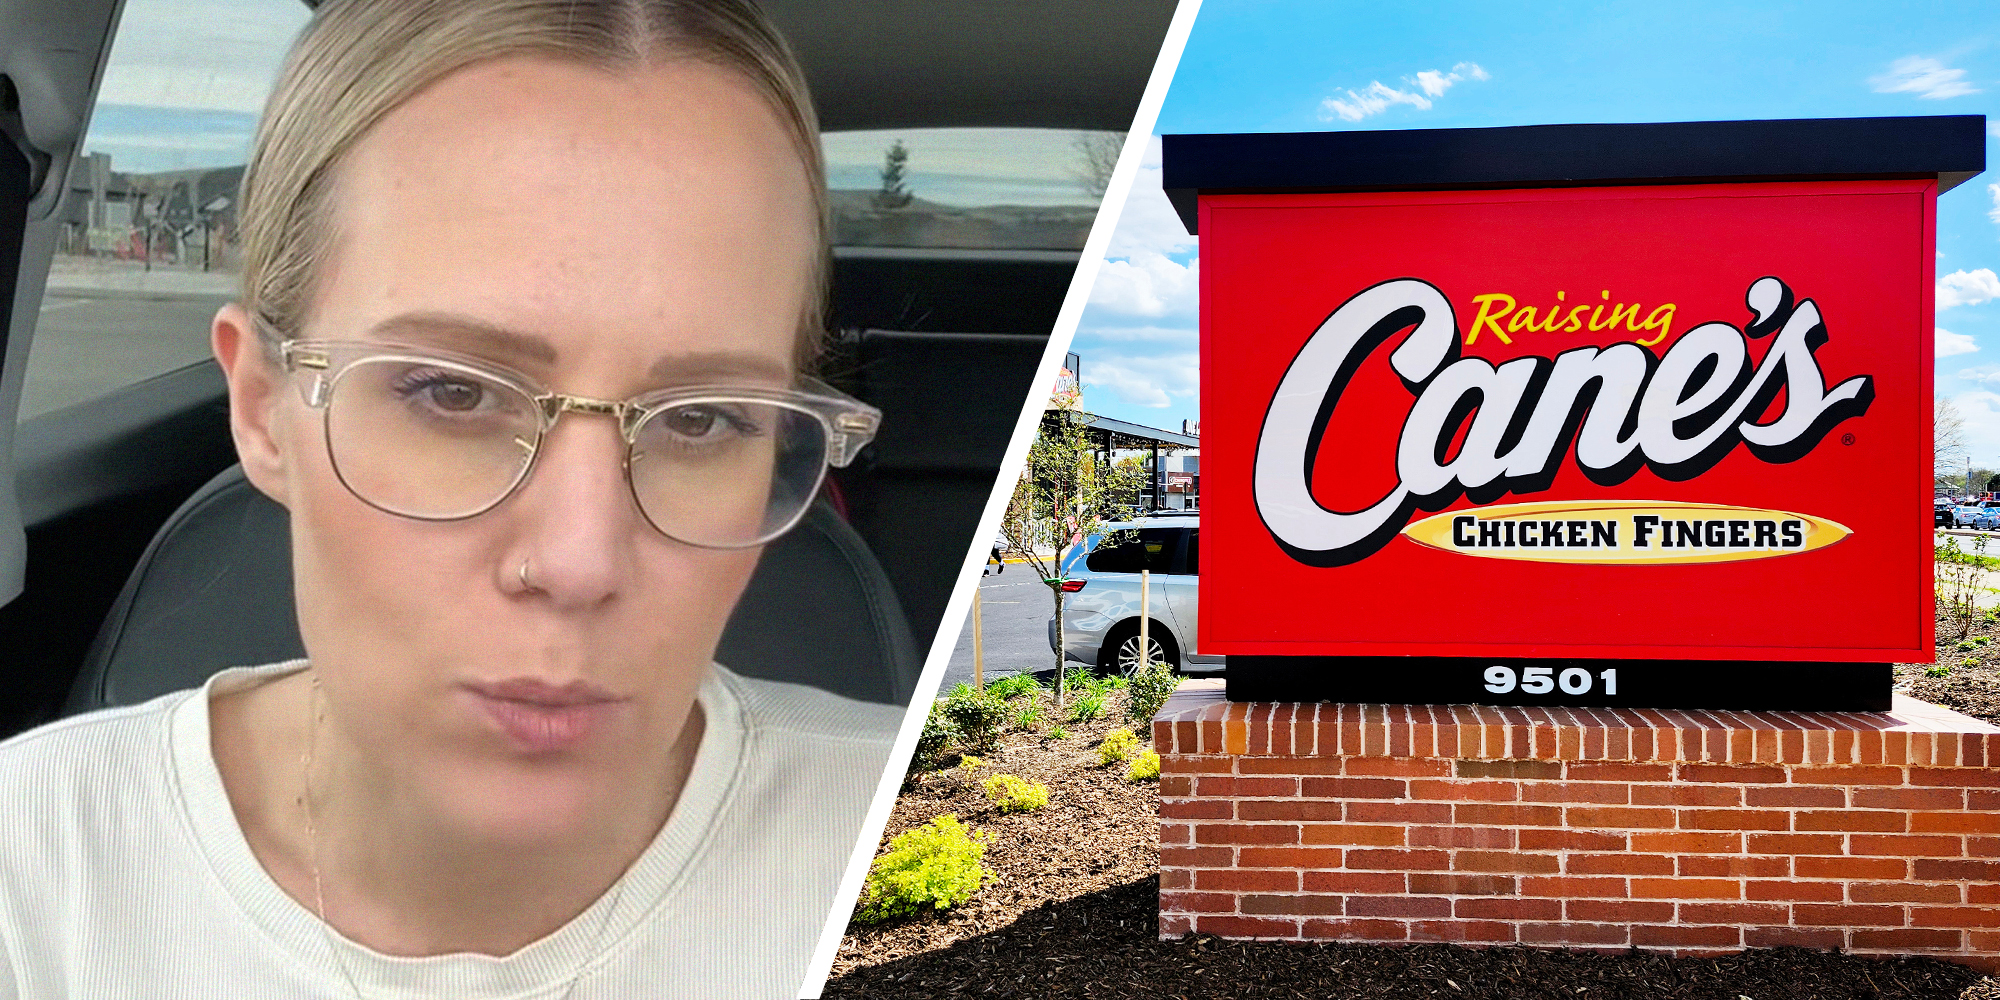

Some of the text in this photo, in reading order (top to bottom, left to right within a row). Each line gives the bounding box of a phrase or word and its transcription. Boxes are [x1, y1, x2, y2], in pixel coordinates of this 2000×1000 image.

[1466, 290, 1677, 346] Raising
[1253, 277, 1874, 567] Cane's
[1452, 514, 1803, 549] CHICKEN FINGERS
[1483, 665, 1617, 696] 9501
